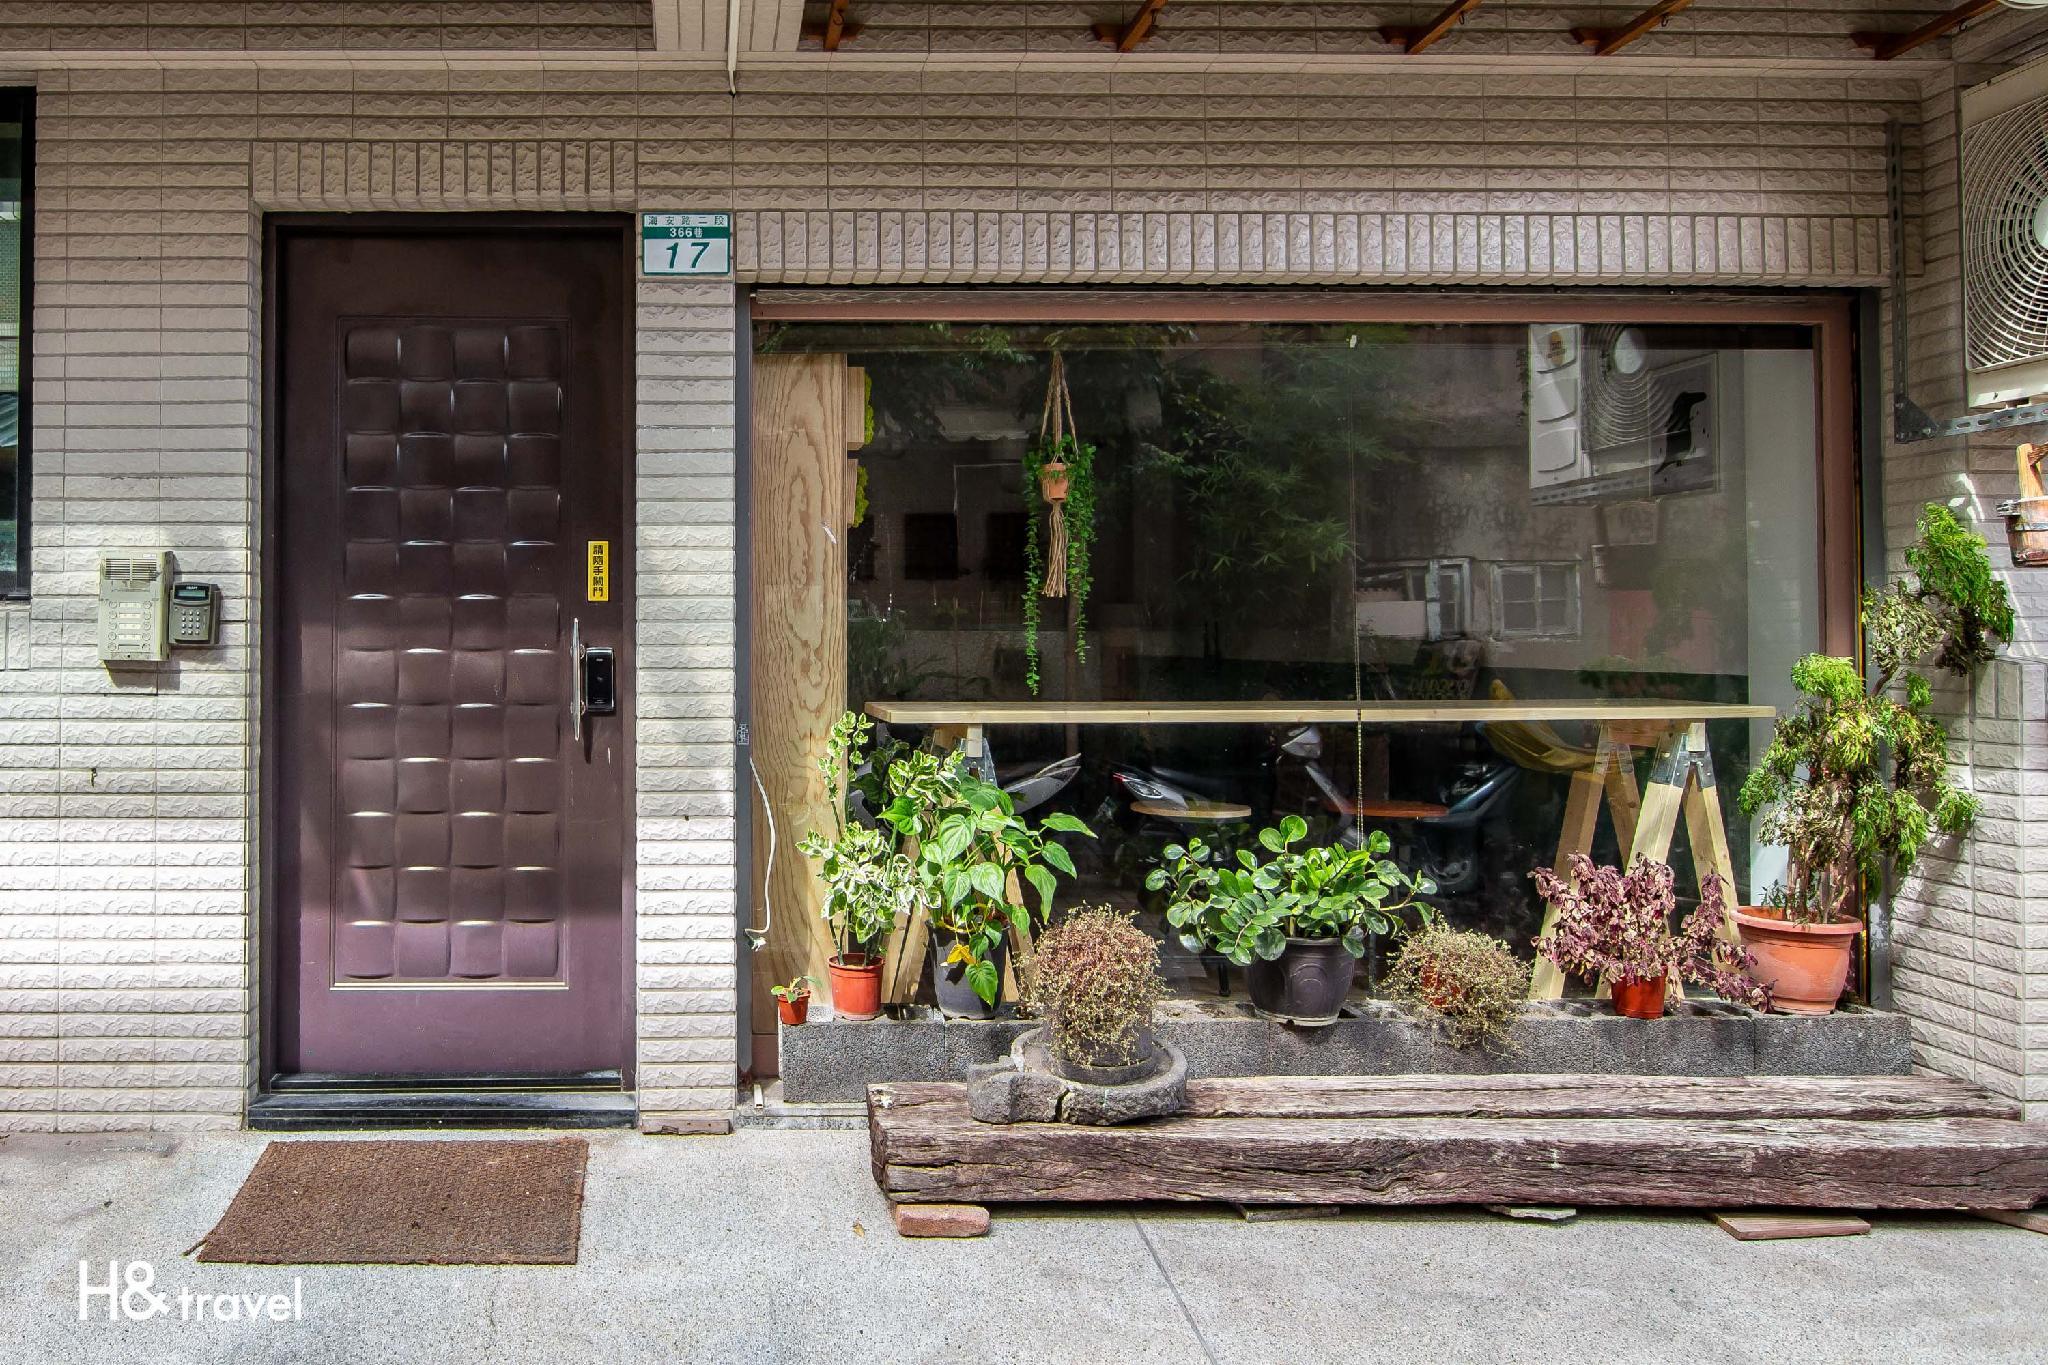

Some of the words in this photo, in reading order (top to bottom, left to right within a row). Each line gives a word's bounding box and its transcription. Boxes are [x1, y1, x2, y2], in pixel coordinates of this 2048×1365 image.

[669, 227, 703, 238] 366巷
[666, 242, 710, 268] 17
[592, 544, 603, 597] 請隨手關門
